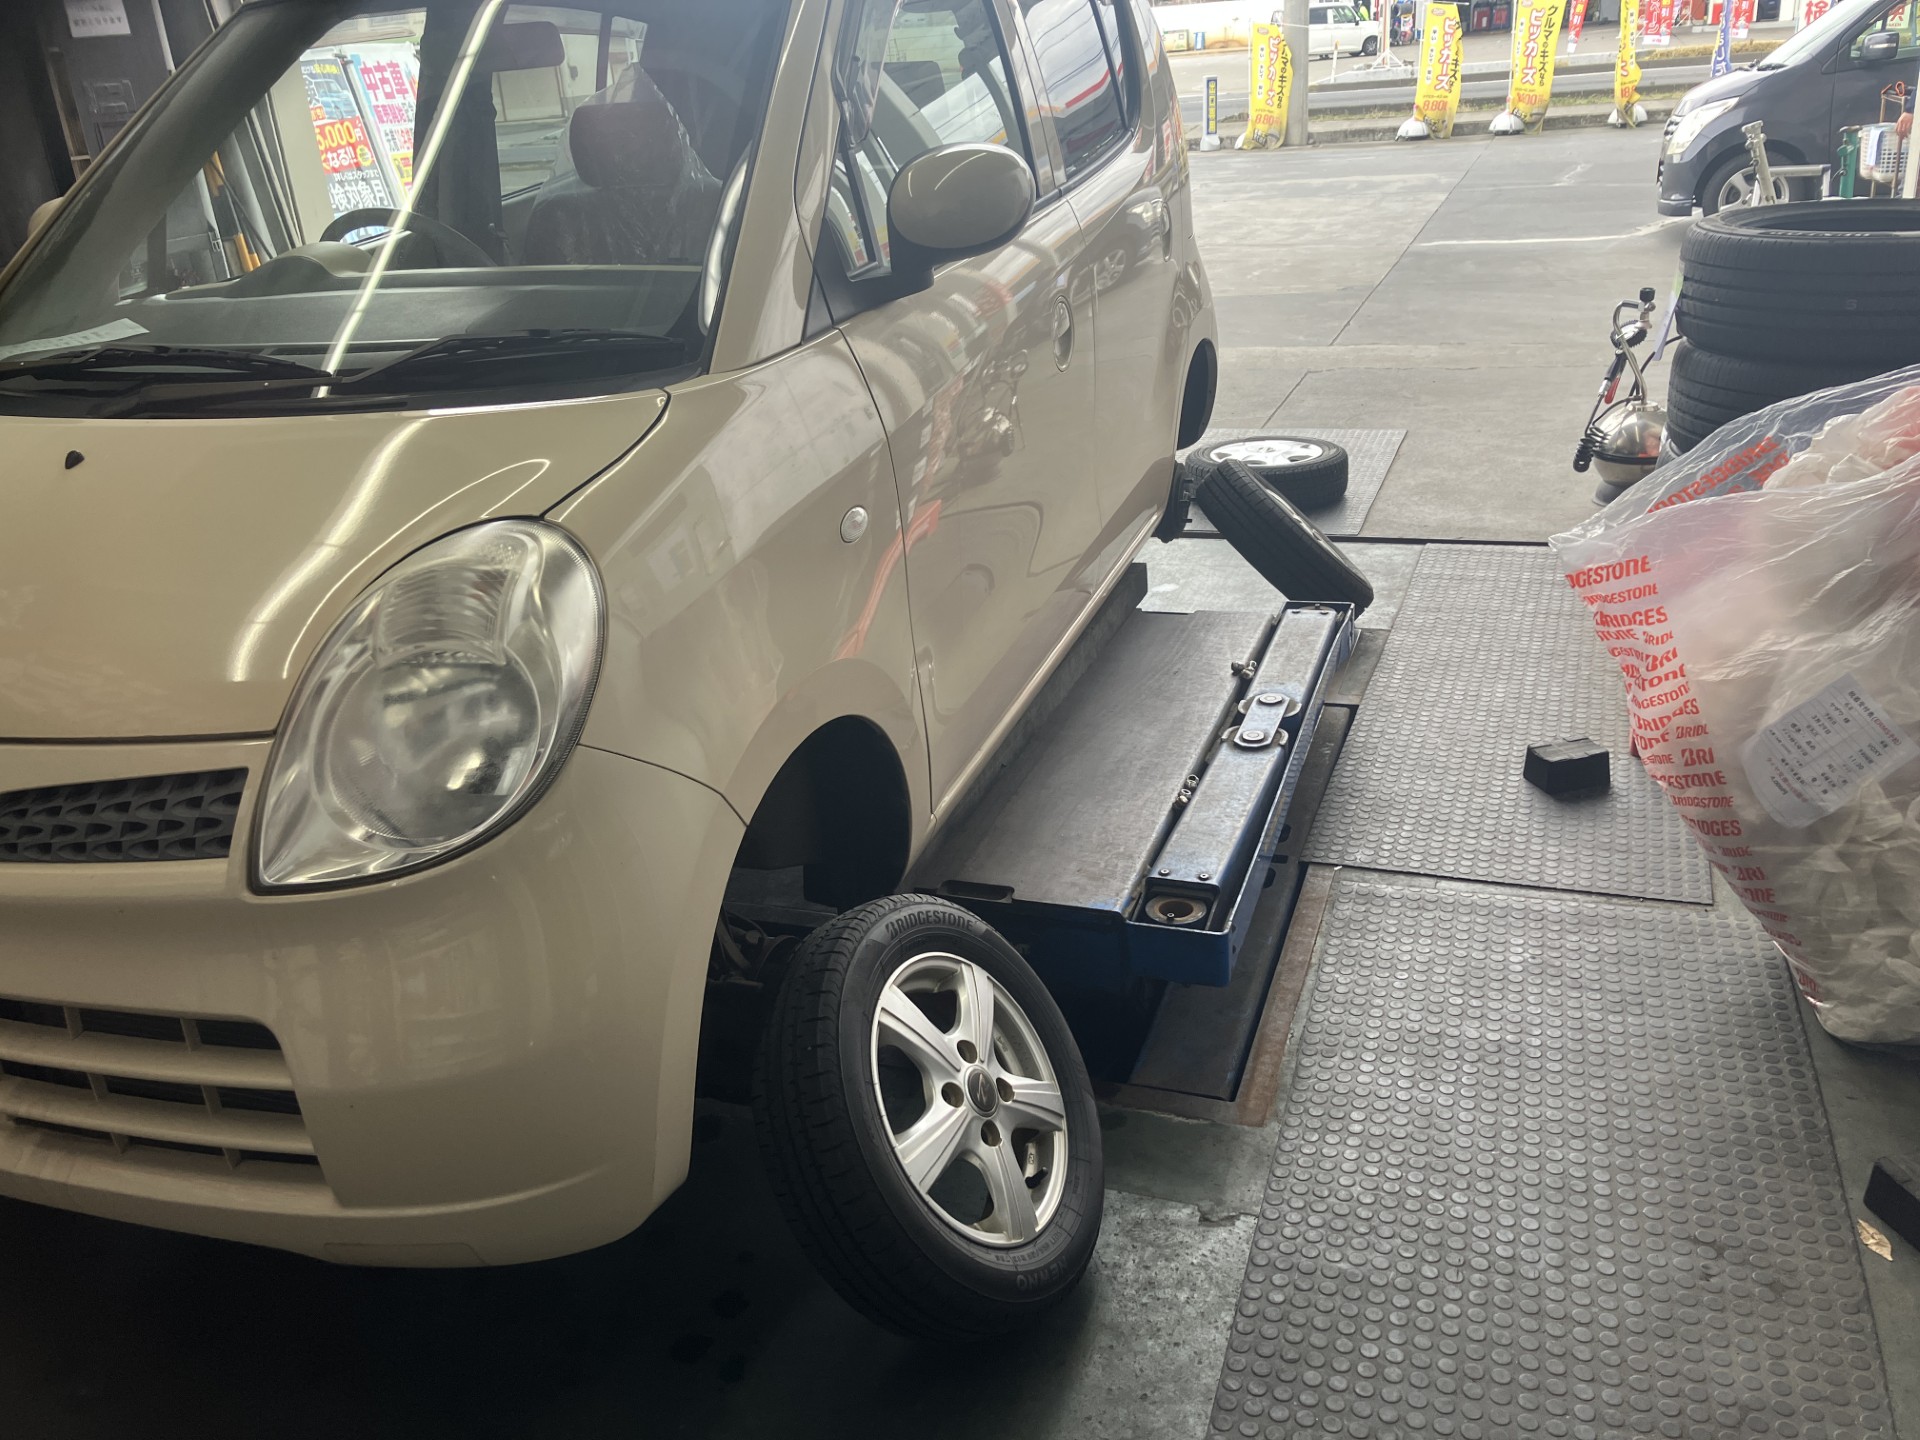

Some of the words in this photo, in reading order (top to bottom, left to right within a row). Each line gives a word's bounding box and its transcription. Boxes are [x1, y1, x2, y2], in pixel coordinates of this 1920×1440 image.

[1435, 16, 1457, 91] ピッカーズ
[1521, 8, 1546, 85] ピッカーズ
[1539, 5, 1558, 86] クルマのキズなら
[360, 60, 410, 102] 中古車
[328, 179, 389, 211] 検対象月
[1681, 747, 1715, 767] BRI
[885, 910, 974, 939] BRIDGESTONE
